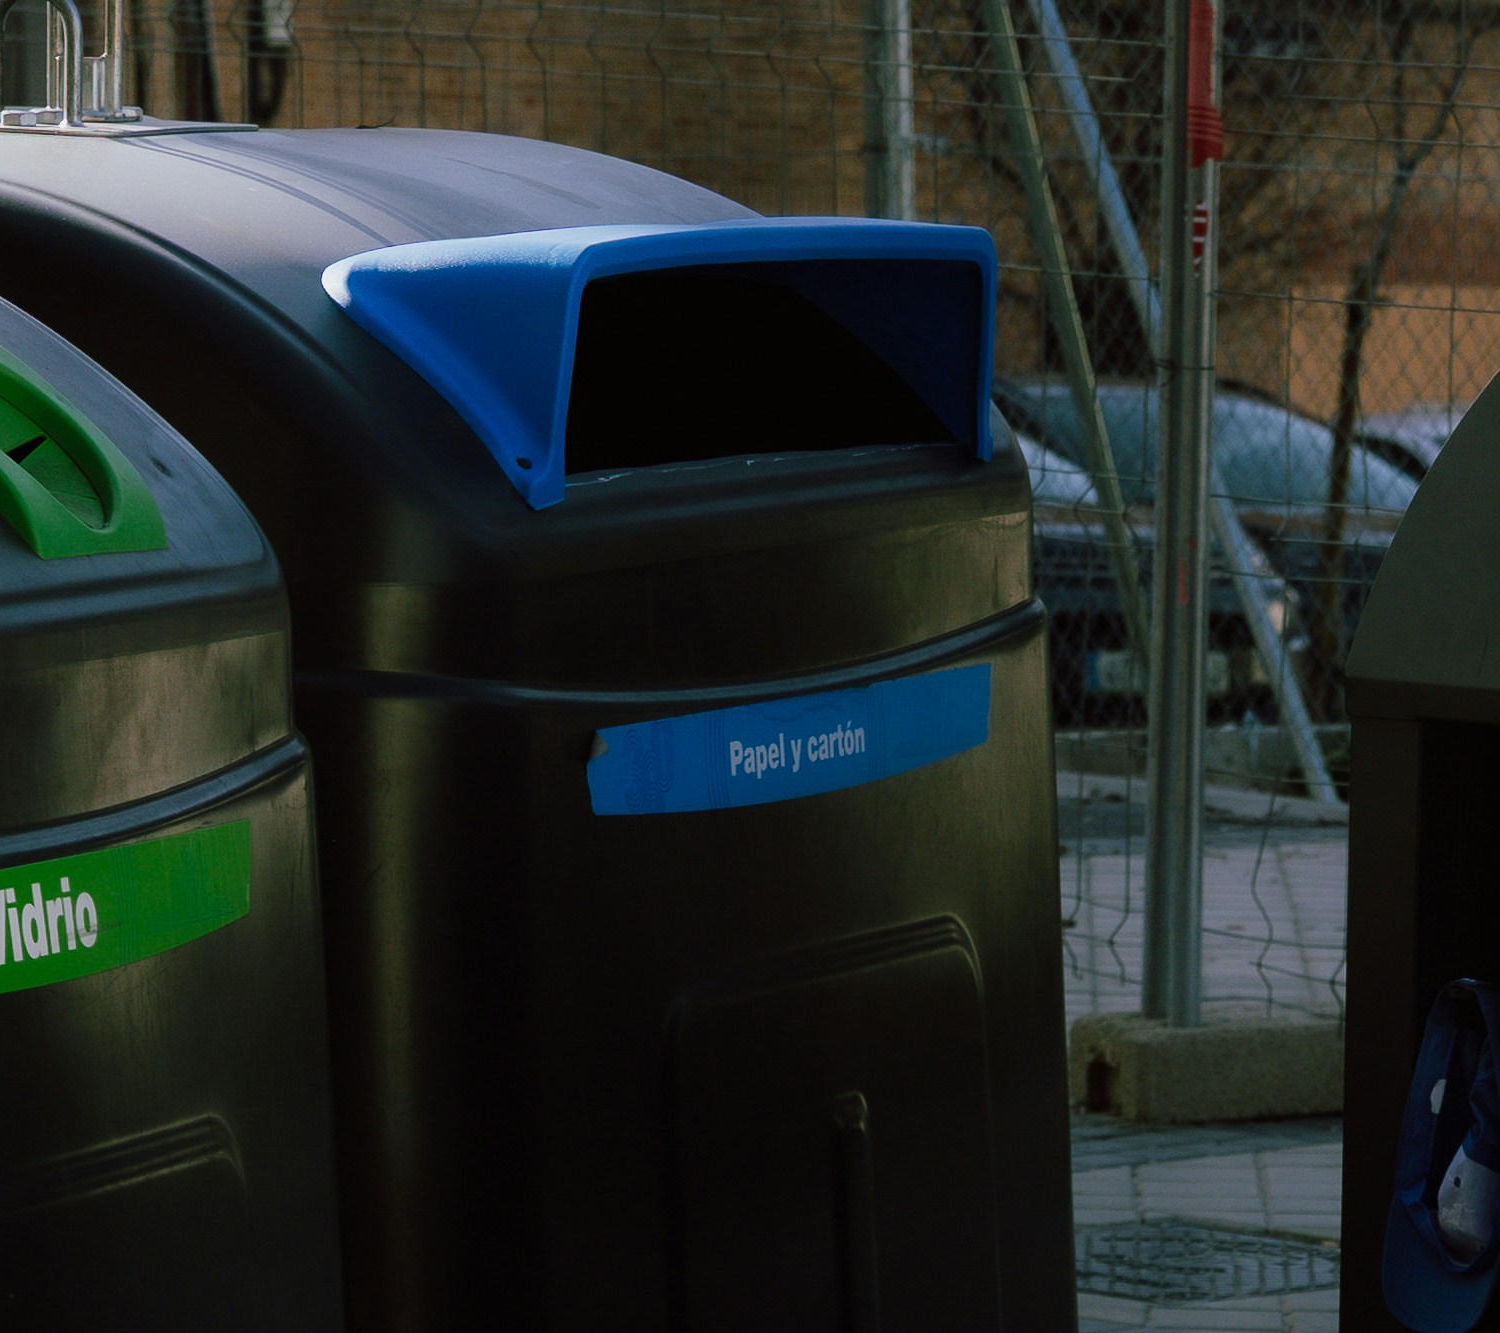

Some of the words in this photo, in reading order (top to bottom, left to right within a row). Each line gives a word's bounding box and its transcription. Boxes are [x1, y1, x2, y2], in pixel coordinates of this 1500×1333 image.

[729, 732, 786, 779] Papel
[791, 739, 802, 772] y
[806, 720, 866, 763] cartón
